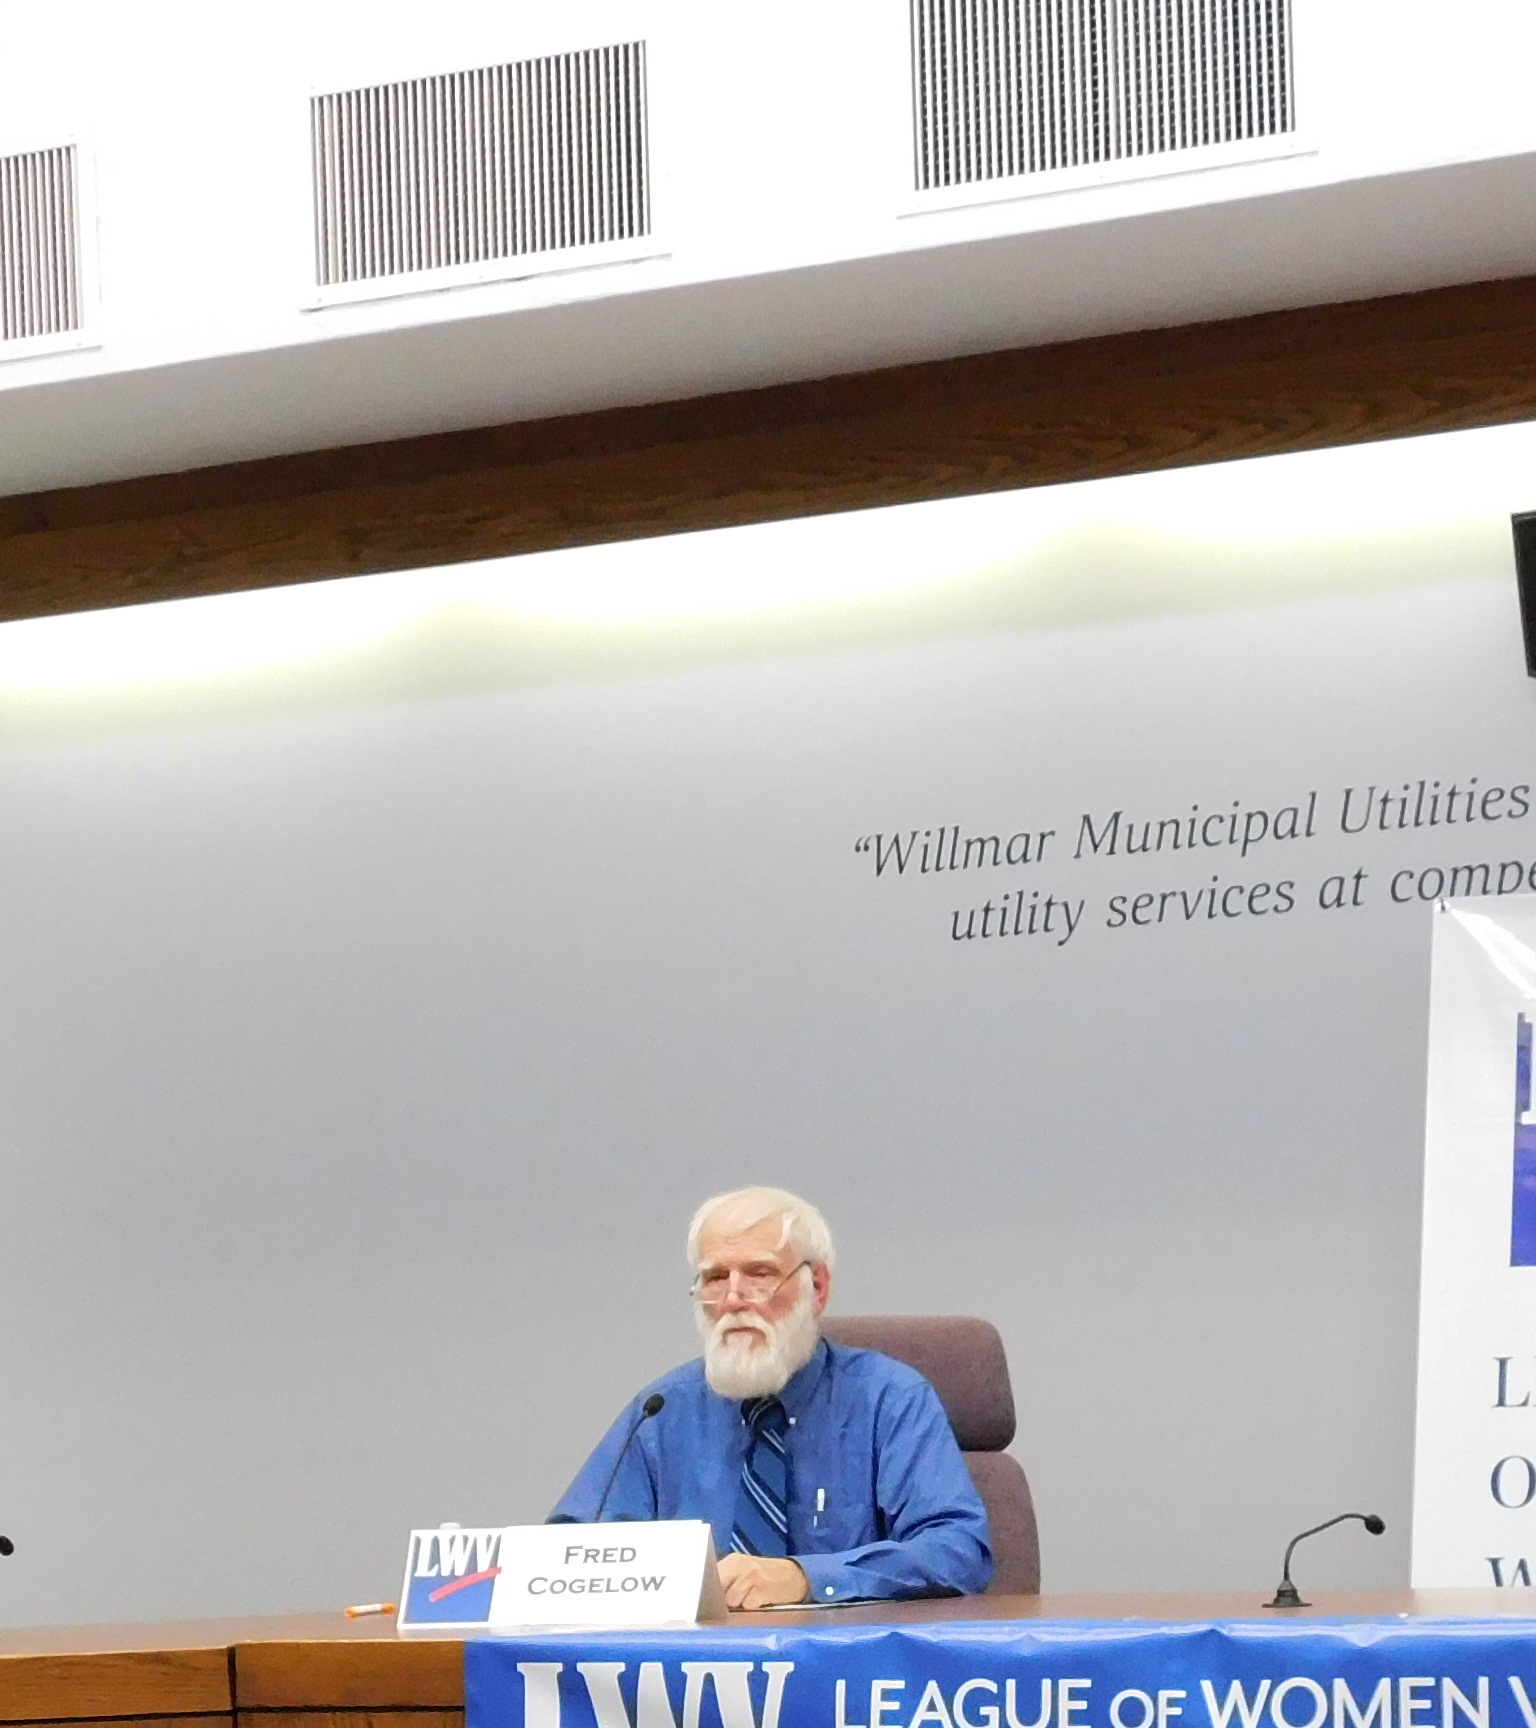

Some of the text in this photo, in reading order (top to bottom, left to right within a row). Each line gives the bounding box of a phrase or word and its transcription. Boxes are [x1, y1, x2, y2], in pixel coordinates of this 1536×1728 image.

[853, 825, 1055, 880] “Willmar
[1073, 792, 1318, 860] Municipal
[1340, 779, 1531, 835] Utilities
[950, 885, 1085, 946] utility
[1106, 873, 1295, 929] services
[1318, 867, 1369, 909] at
[413, 1533, 502, 1578] LWV
[563, 1545, 637, 1565] FRED
[527, 1575, 666, 1596] COGELOW
